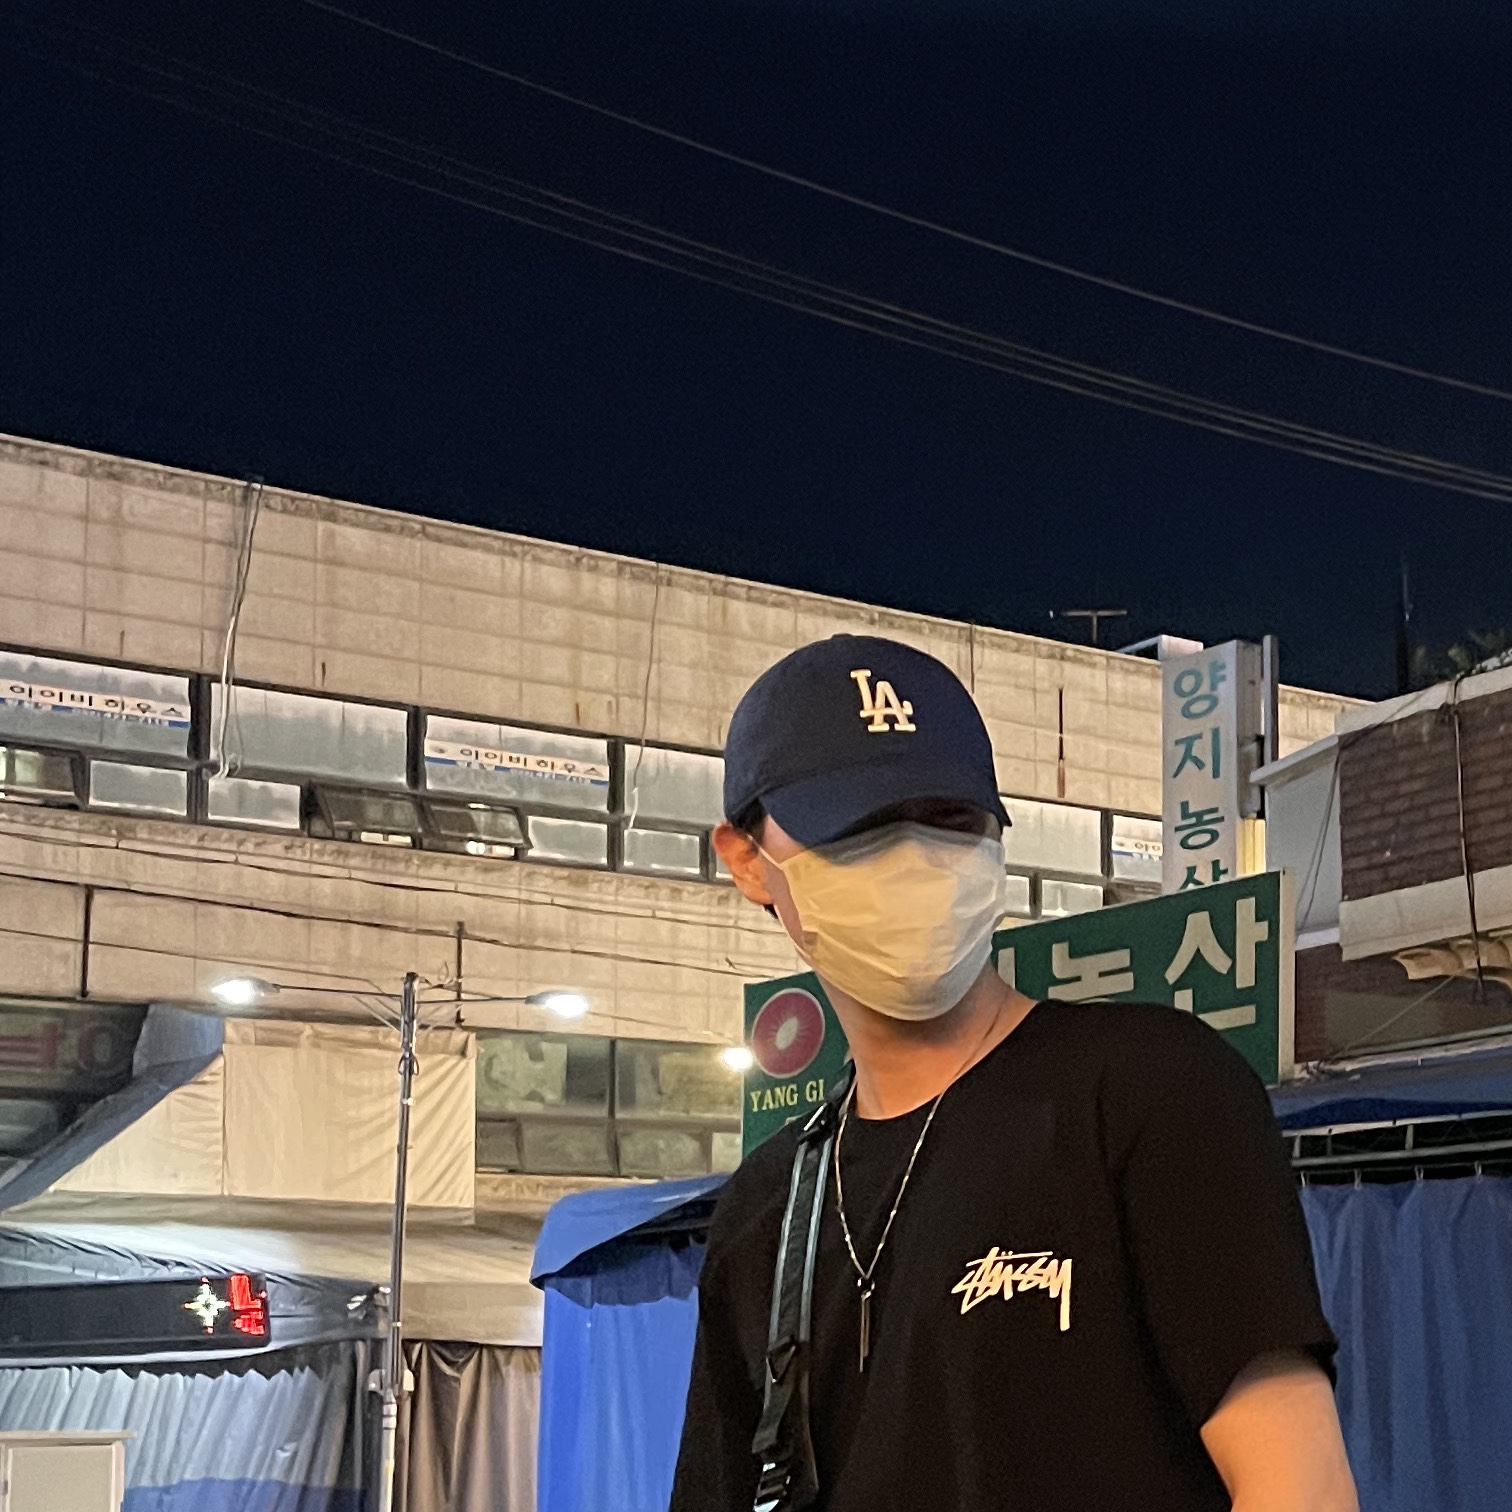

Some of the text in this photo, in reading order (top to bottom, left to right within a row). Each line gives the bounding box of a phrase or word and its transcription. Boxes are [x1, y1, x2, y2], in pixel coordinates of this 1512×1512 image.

[850, 668, 916, 732] LA
[751, 1079, 825, 1112] YANG GI
